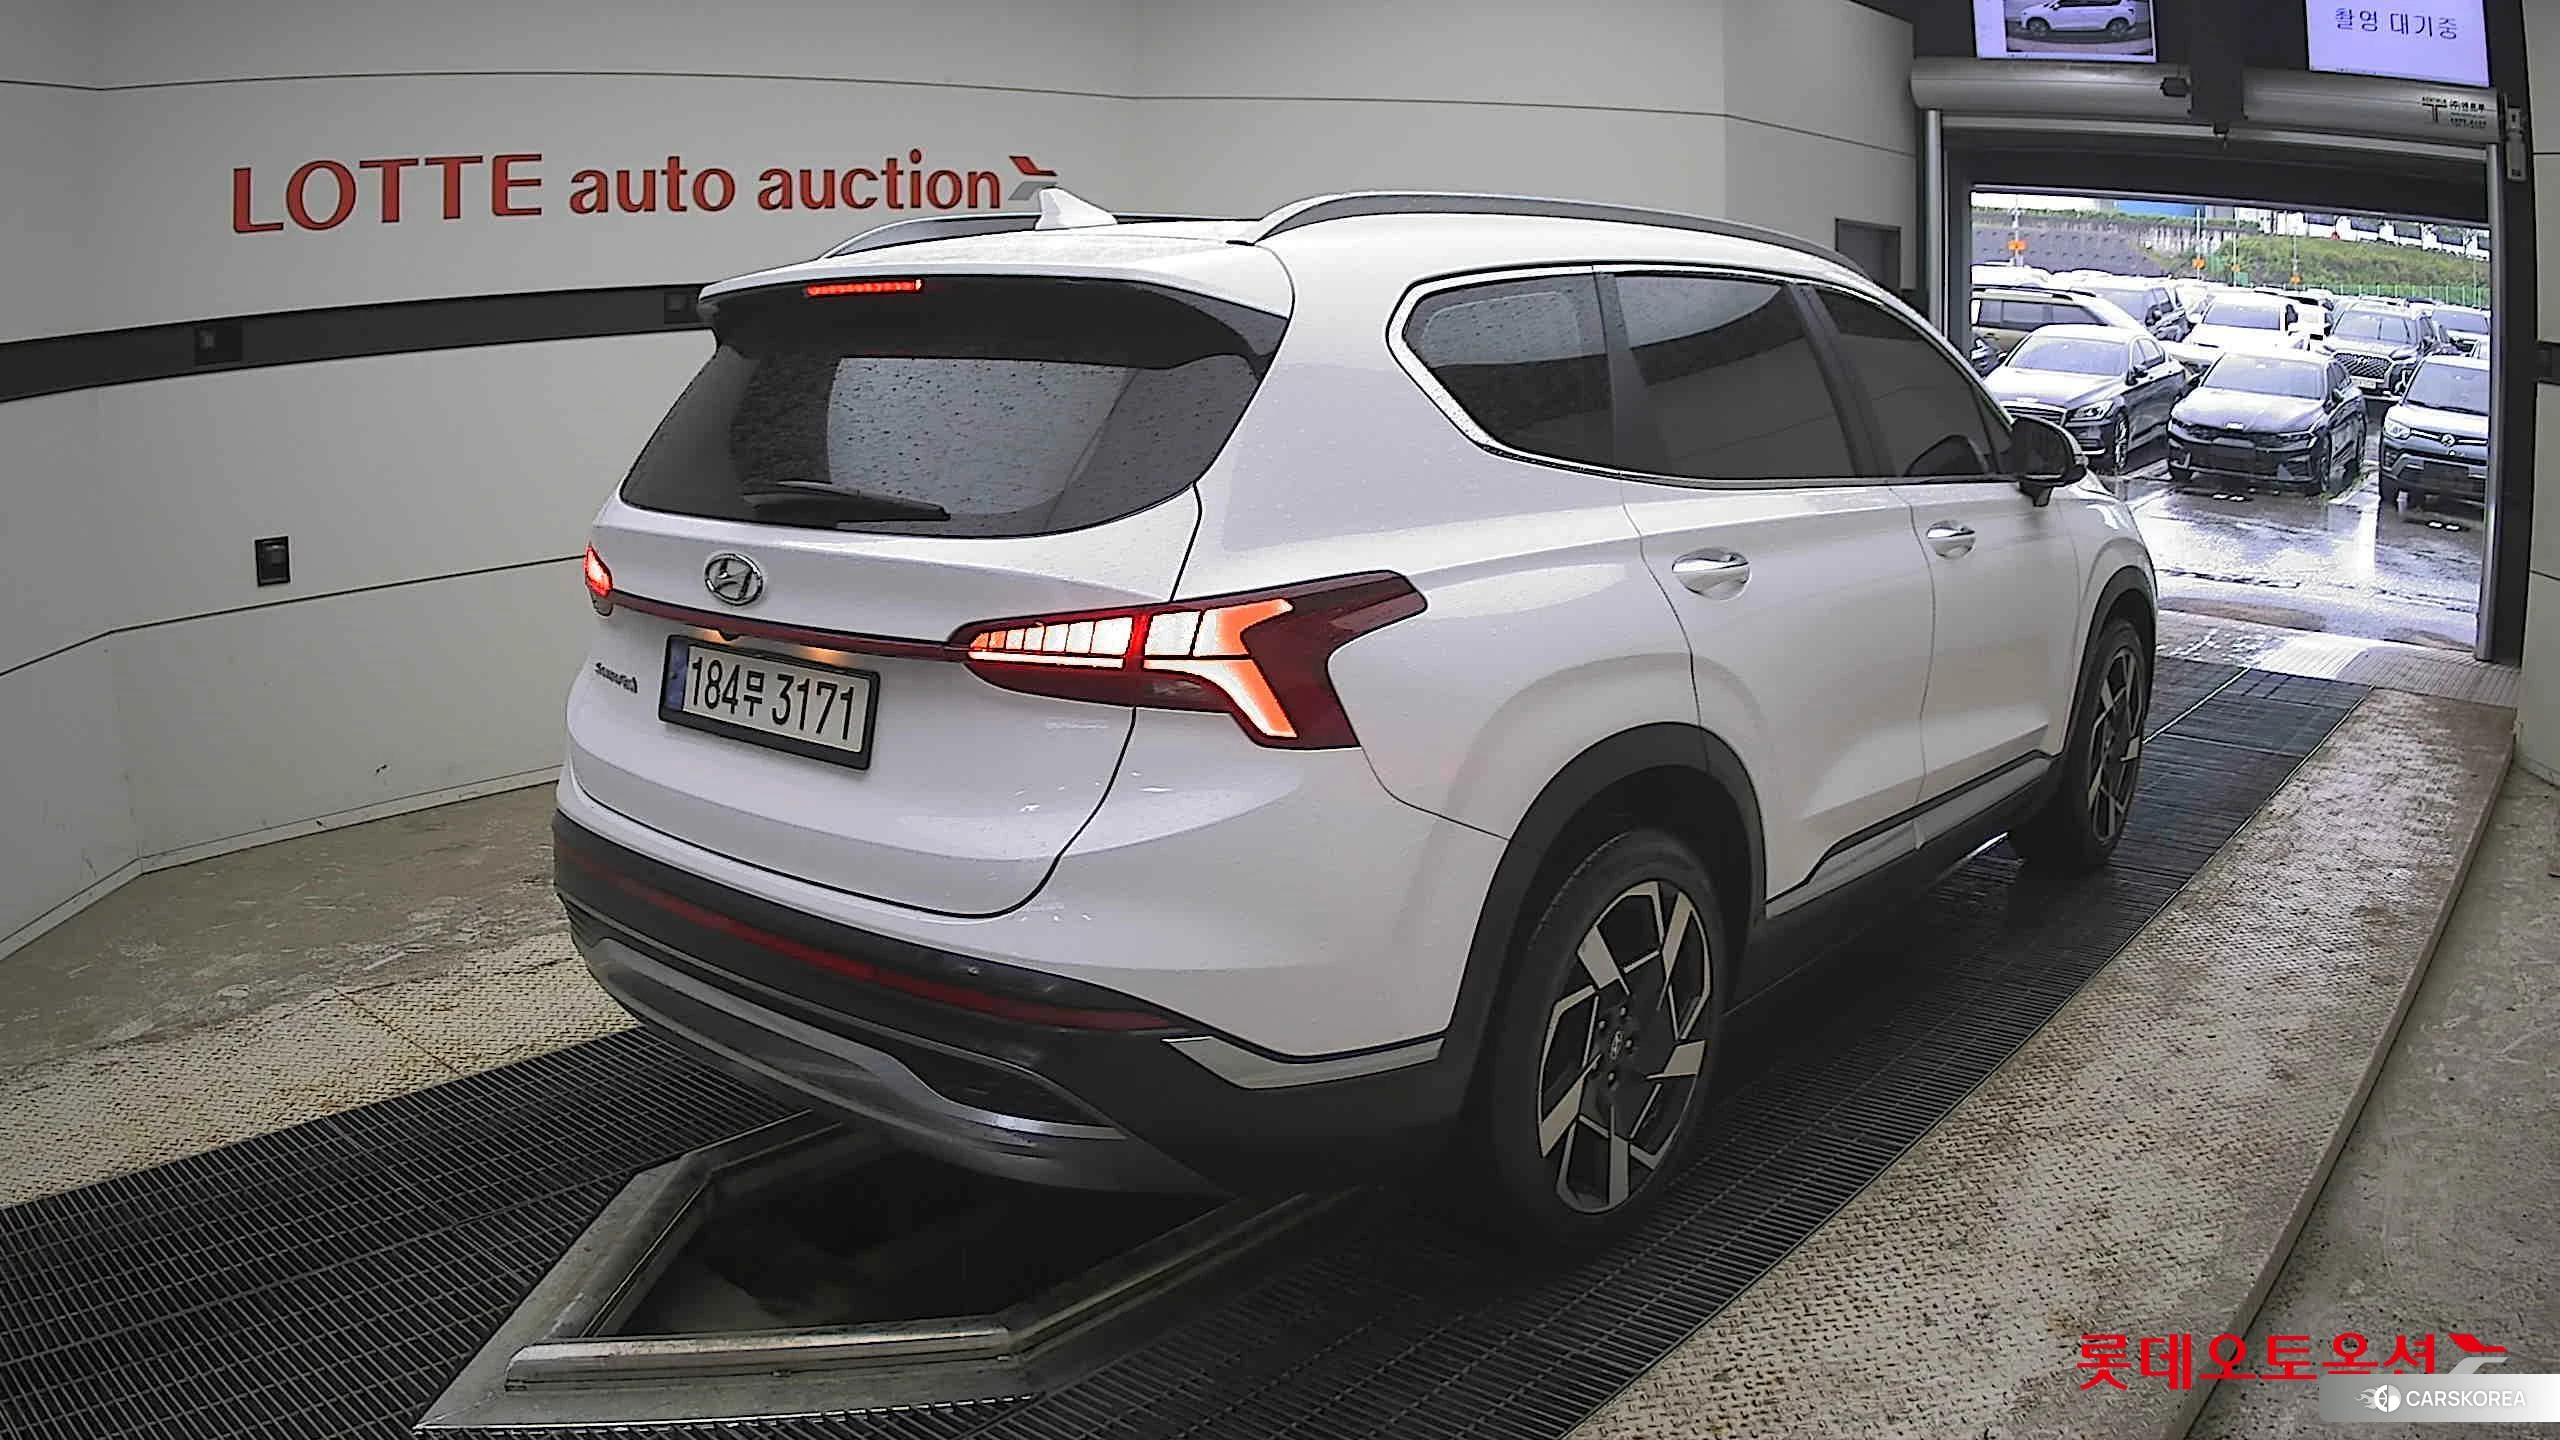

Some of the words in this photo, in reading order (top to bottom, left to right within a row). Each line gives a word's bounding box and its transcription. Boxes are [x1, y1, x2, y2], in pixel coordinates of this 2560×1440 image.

[2335, 7, 2378, 32] 촬영
[2389, 12, 2457, 40] 대기중
[232, 153, 542, 233] LOTTE
[569, 155, 736, 213] auto
[757, 148, 1001, 210] auction
[771, 672, 856, 741] 3171
